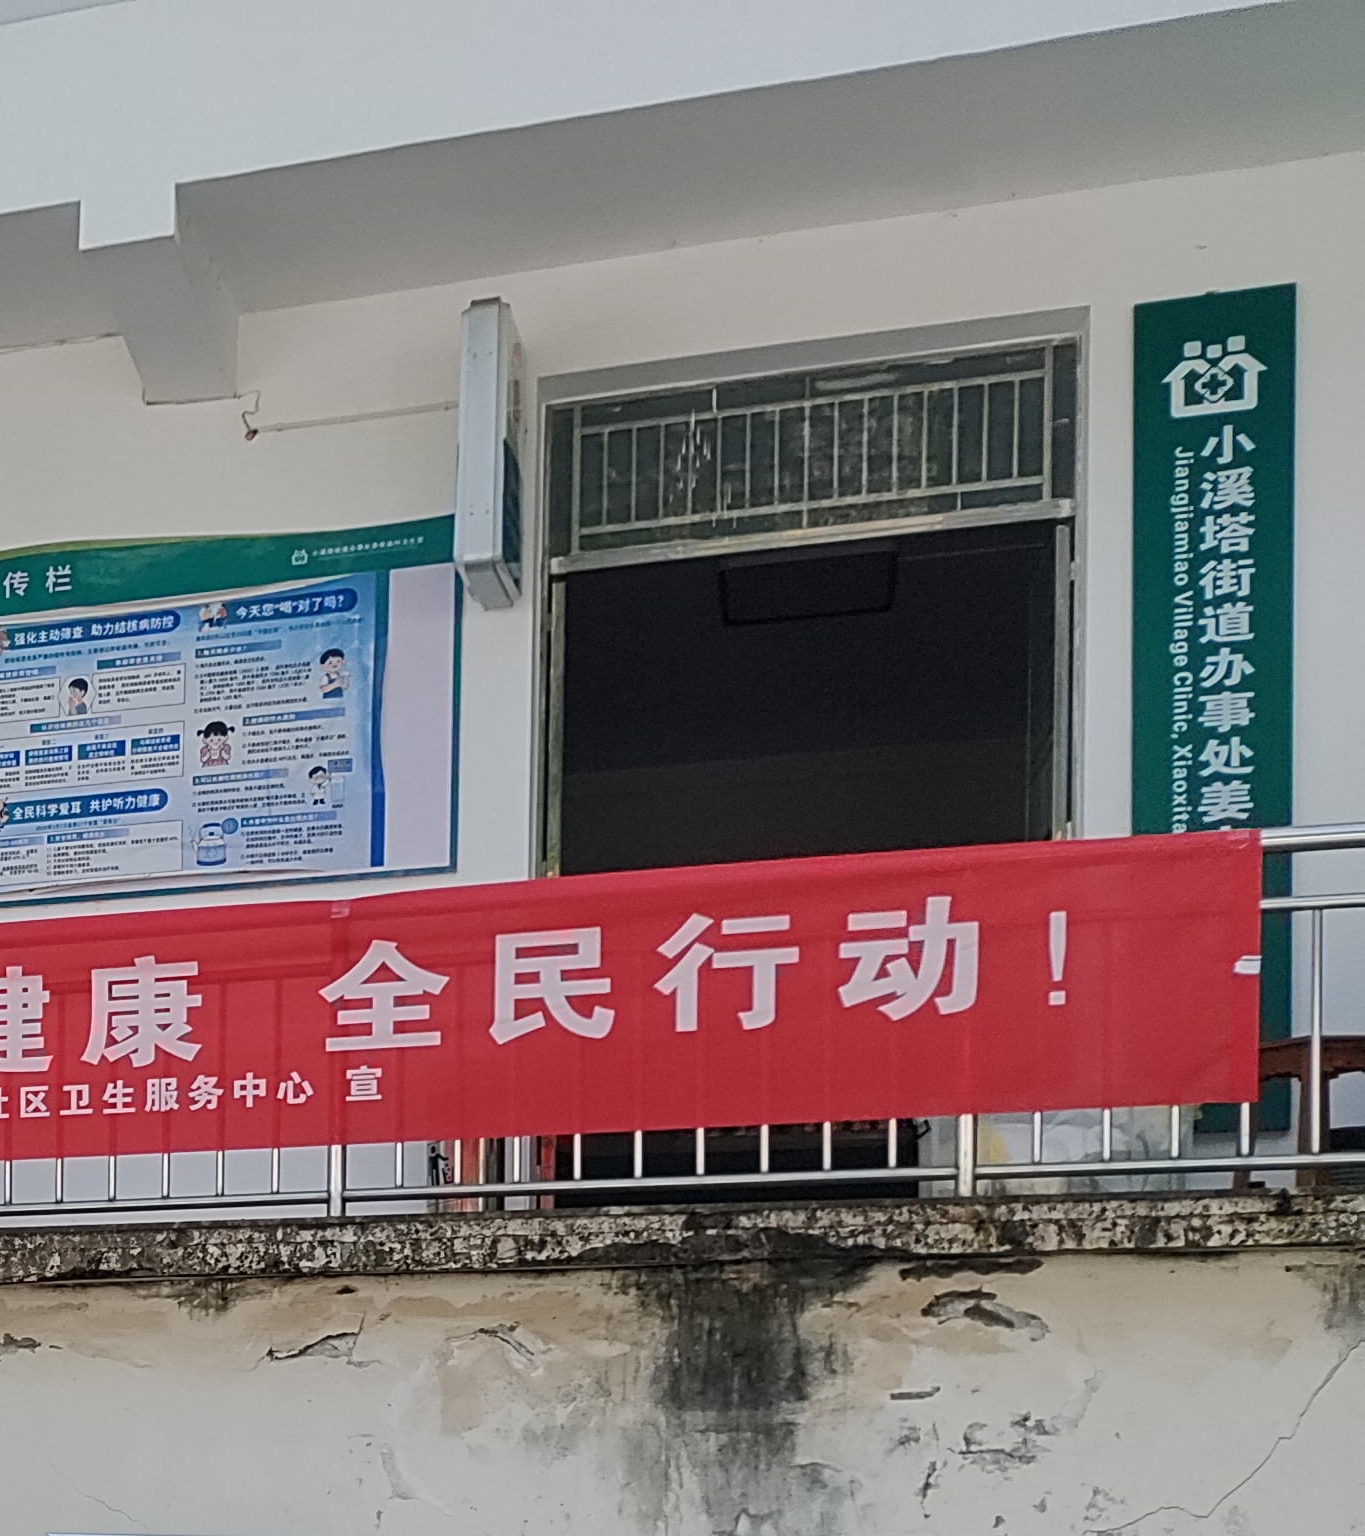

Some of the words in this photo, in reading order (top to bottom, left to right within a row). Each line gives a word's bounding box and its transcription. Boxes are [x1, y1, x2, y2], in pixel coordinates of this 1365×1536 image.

[1171, 446, 1195, 588] Jiangjiamiao
[14, 625, 84, 646] 强化主动筛查
[90, 614, 176, 637] 助力结核病防控
[1171, 590, 1195, 668] Village
[1197, 424, 1257, 831] 小溪塔街道办事处姜
[1170, 671, 1195, 740] Clinic,
[12, 801, 82, 821] 全民科学爱耳
[89, 793, 161, 812] 共护听力健康
[319, 895, 1067, 1052] 全民行动！
[345, 1065, 383, 1102] 宣
